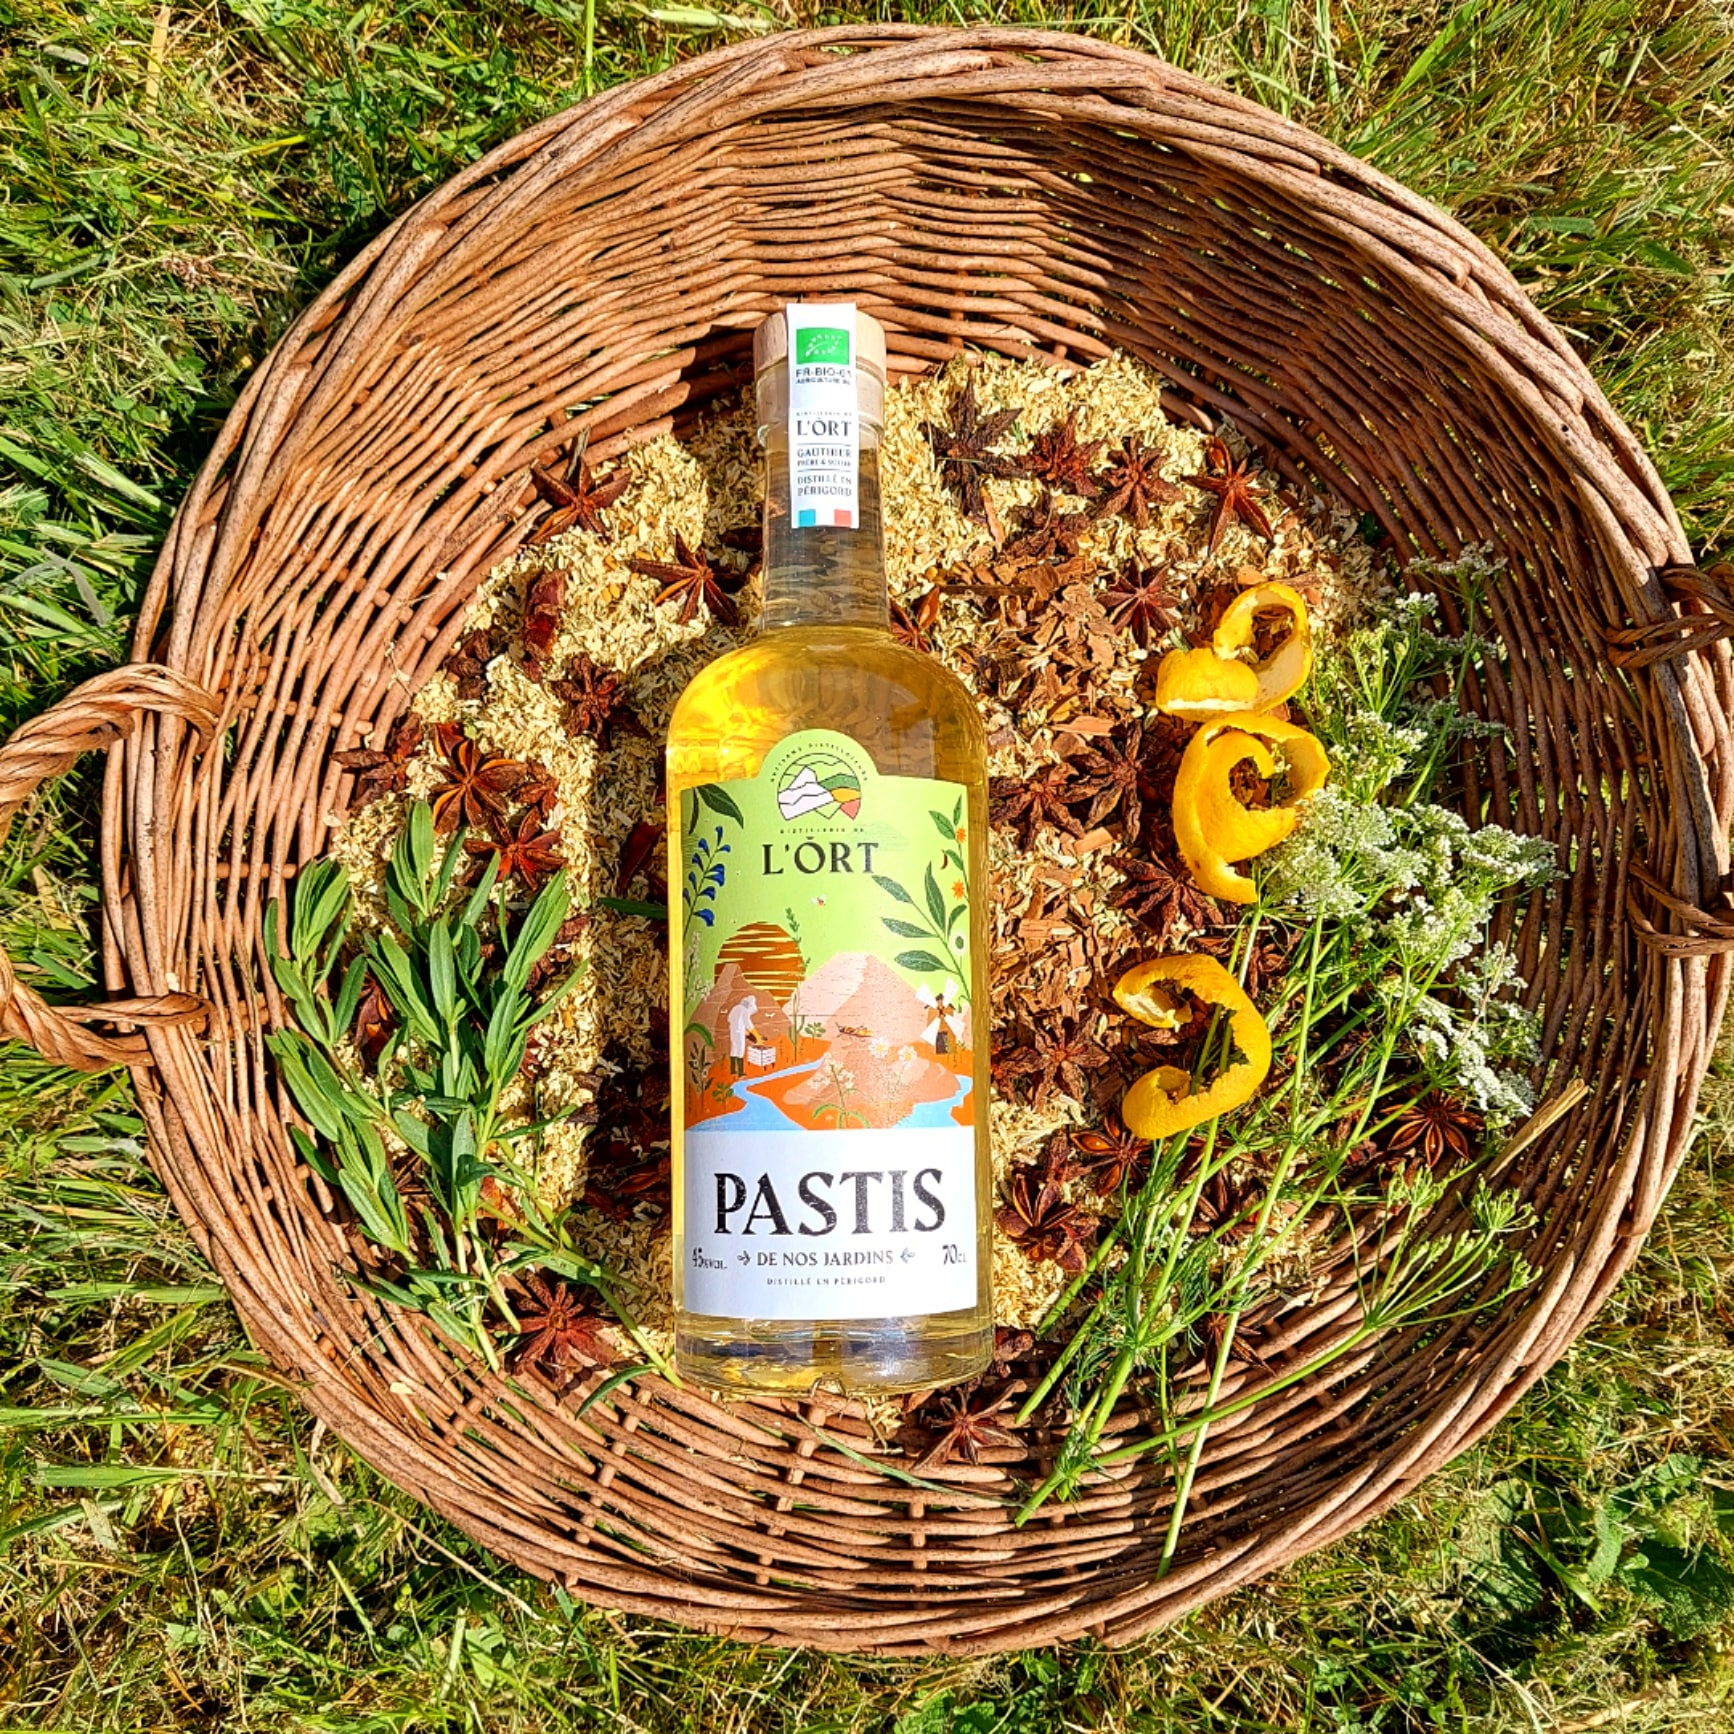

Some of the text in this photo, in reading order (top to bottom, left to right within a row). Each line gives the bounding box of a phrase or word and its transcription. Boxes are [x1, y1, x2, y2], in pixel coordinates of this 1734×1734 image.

[714, 1168, 946, 1237] PASTIS
[757, 1250, 894, 1266] DE NOS JARDINS
